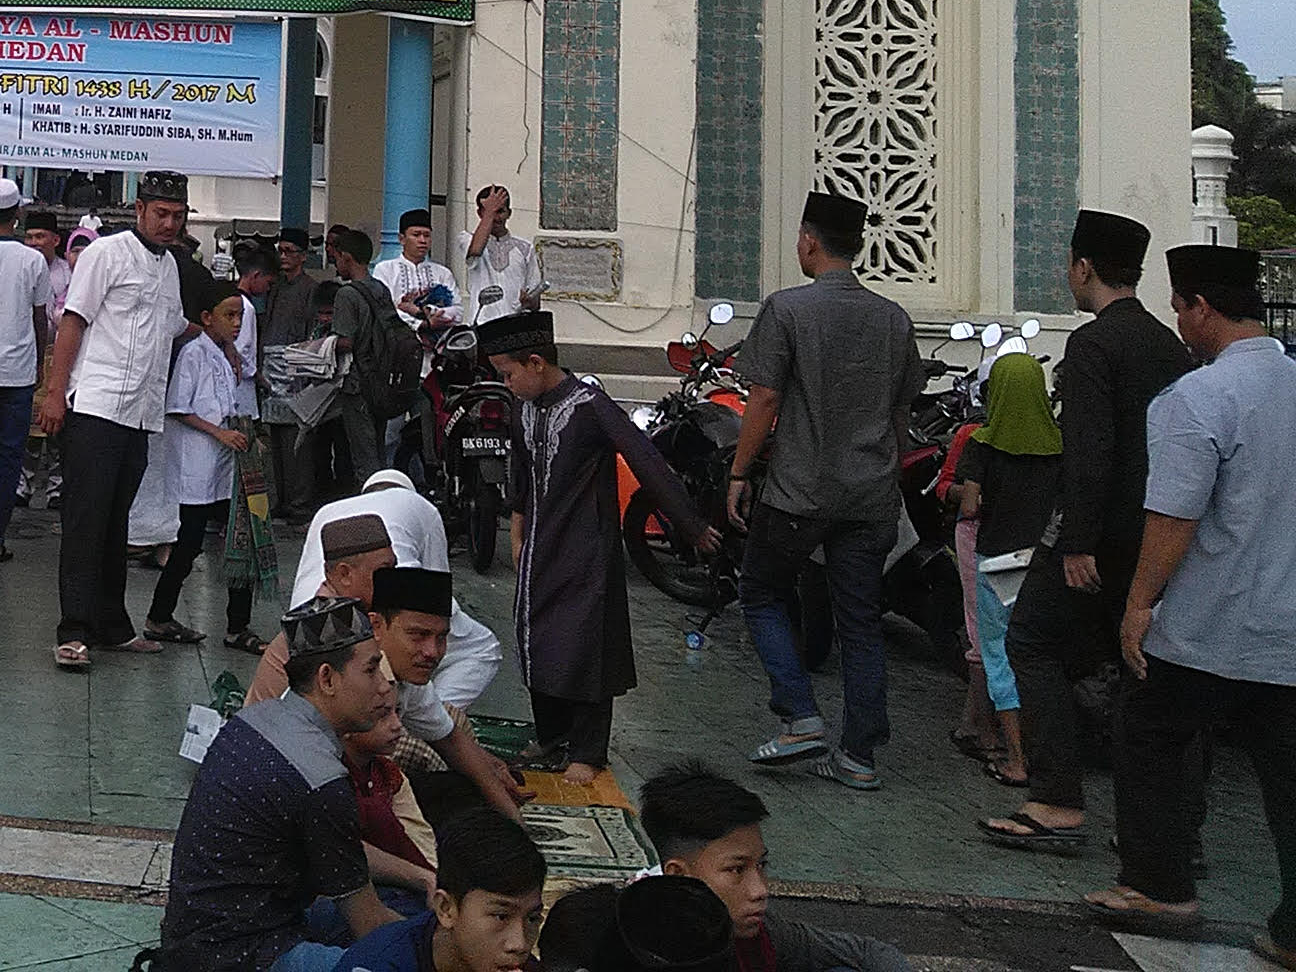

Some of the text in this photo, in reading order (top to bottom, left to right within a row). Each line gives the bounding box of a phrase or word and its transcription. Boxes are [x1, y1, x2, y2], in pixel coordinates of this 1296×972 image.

[43, 18, 81, 37] AL
[109, 20, 233, 44] MASHUN
[0, 73, 69, 95] FITRI
[75, 79, 122, 99] 1438
[226, 83, 257, 104] M
[3, 103, 11, 114] H
[32, 103, 61, 115] IMAM
[81, 105, 92, 117] Ir.
[94, 106, 106, 117] H.
[108, 106, 137, 119] ZAINI
[140, 108, 172, 120] HAFIZ
[31, 120, 72, 134] KHATIB
[80, 123, 91, 135] H.
[93, 123, 164, 138] SYARIFUDDIN
[166, 126, 195, 142] SIBA,
[197, 128, 216, 140] SH.
[218, 129, 254, 142] M.Hum
[110, 149, 149, 162] MEDAN
